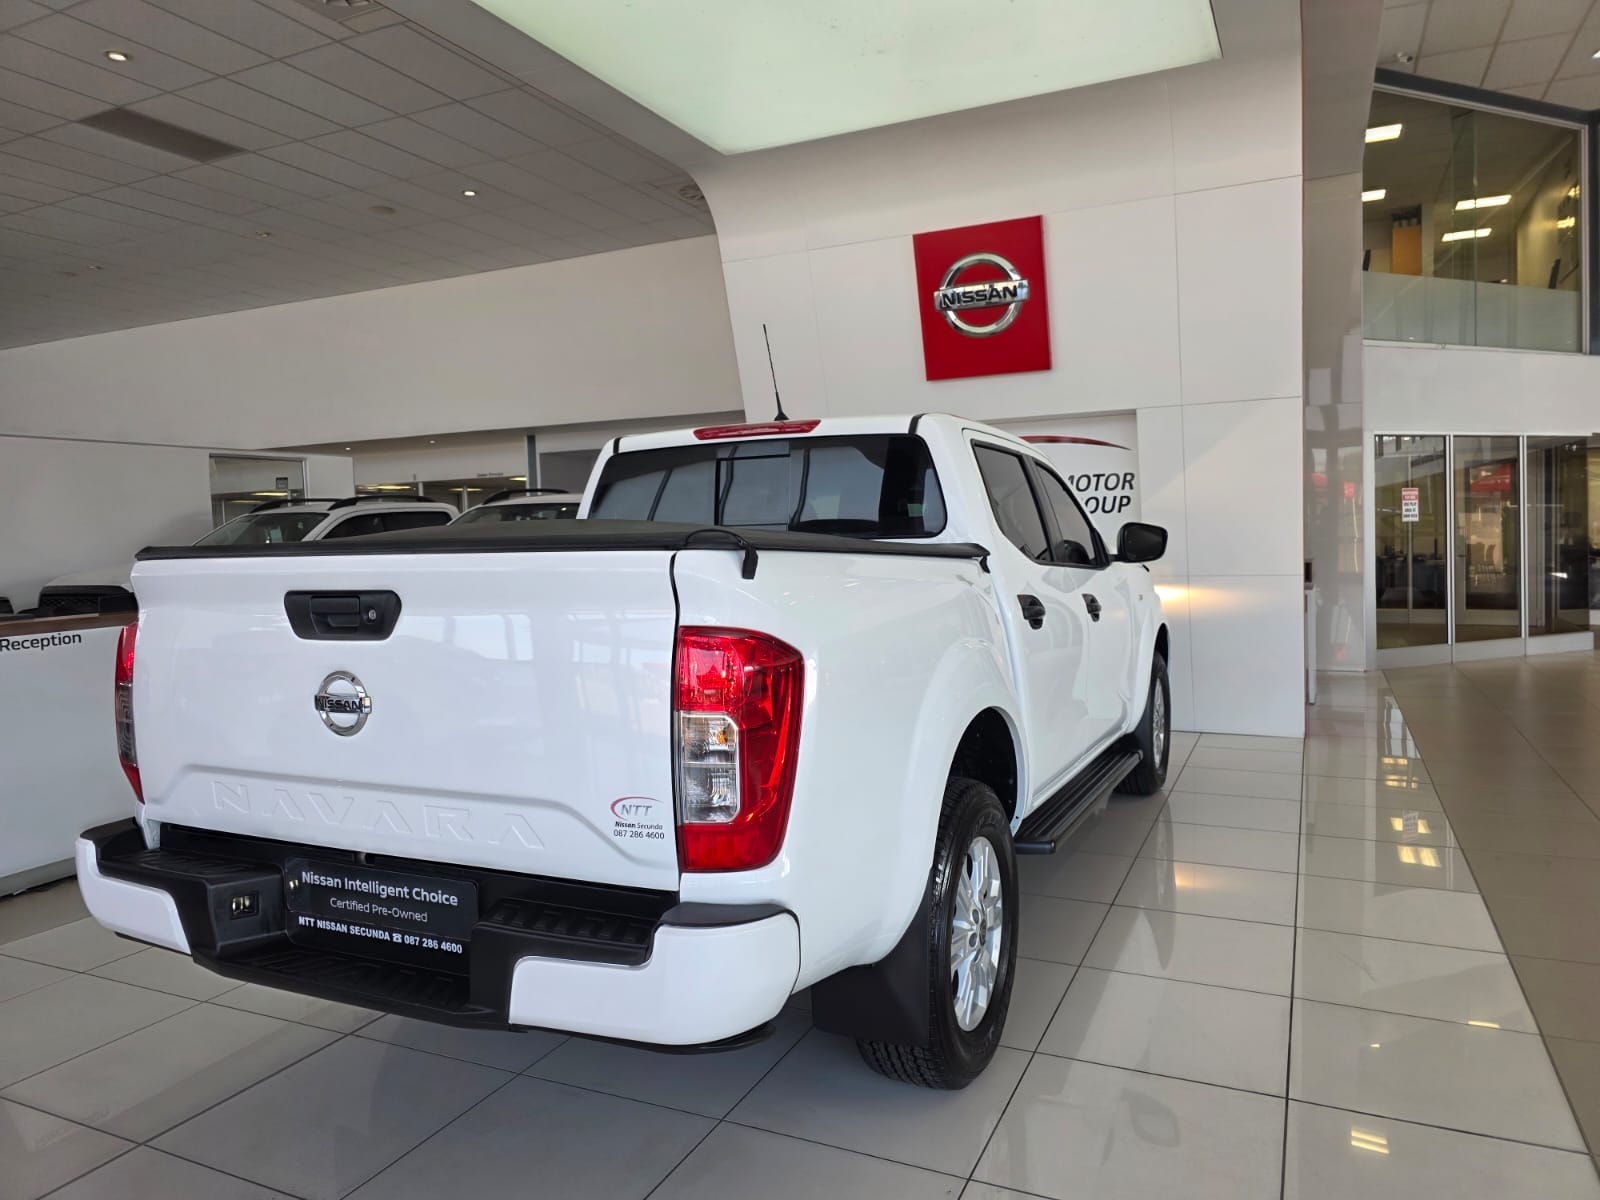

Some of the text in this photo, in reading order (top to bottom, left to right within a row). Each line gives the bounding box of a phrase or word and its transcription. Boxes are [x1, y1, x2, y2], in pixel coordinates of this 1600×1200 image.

[941, 285, 1018, 309] NISSAN
[1084, 495, 1131, 514] OUP
[0, 633, 82, 652] Reception
[317, 696, 361, 711] NISSAN
[210, 780, 545, 849] NAVARA
[620, 804, 653, 817] NTT
[615, 820, 636, 828] Nissan
[613, 829, 665, 839] 087 286 4600
[301, 871, 458, 906] Nissan Intelligent Choice
[329, 897, 428, 922] Certified Pre-Owned
[298, 915, 463, 954] NTT NISSAN SECUNDA 087 286 4600
